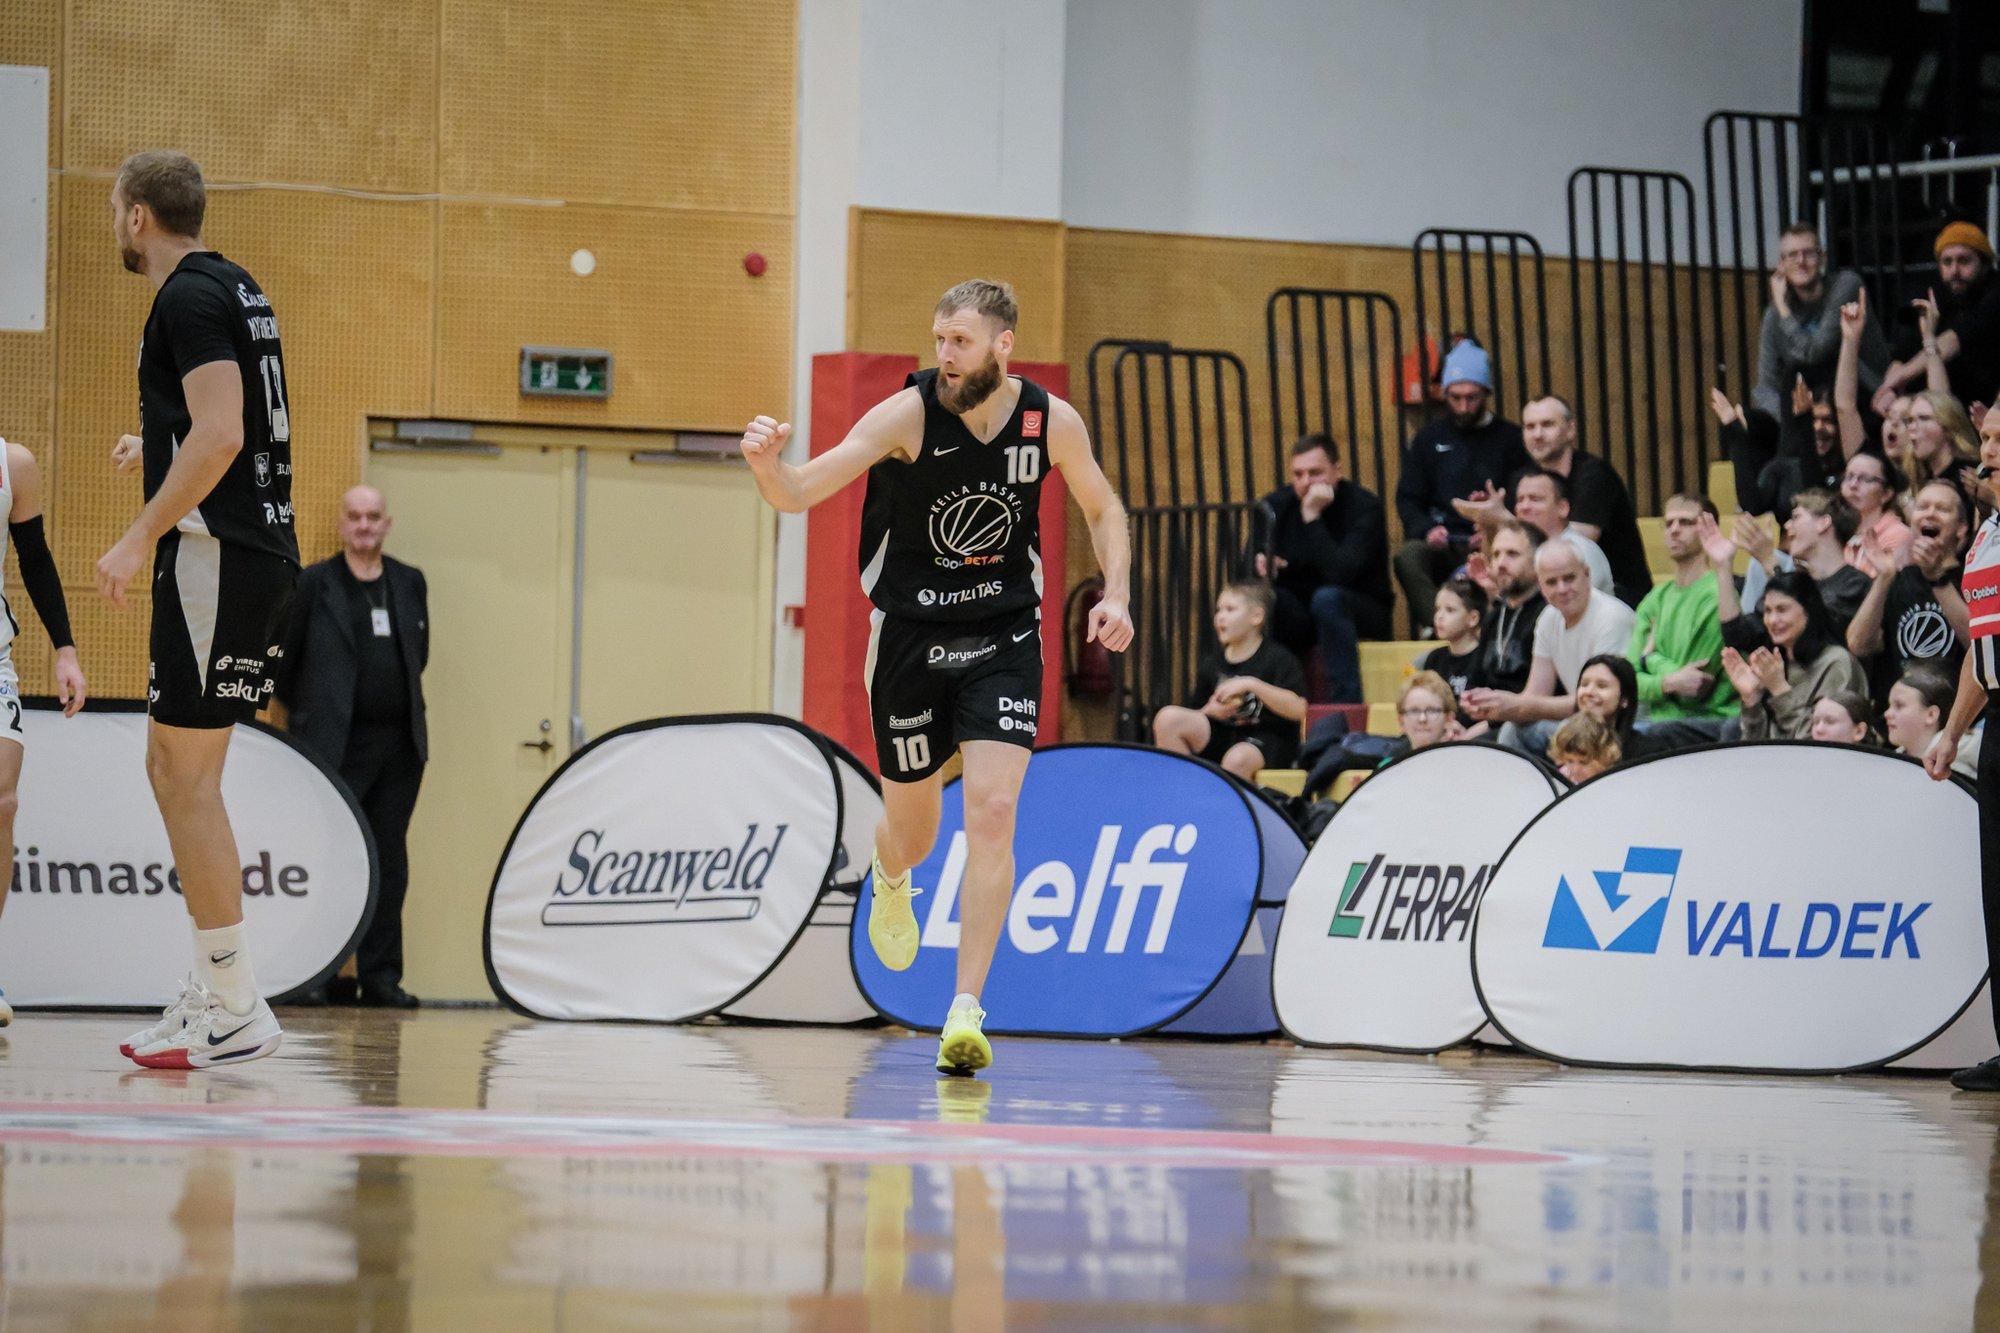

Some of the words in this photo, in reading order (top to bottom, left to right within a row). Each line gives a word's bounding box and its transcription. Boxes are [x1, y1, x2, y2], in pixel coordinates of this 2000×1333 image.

[1004, 445, 1041, 485] 10
[931, 485, 970, 513] KEILA
[939, 580, 1003, 605] UTILITAS
[1971, 585, 1998, 601] Optibet
[948, 644, 997, 662] prysmian
[234, 665, 260, 675] EHITUS
[216, 678, 260, 701] saku
[889, 709, 933, 727] Scanweld
[998, 697, 1036, 717] Delfi
[1015, 719, 1037, 737] Daily
[892, 733, 931, 772] 10
[10, 846, 309, 897] iimasede
[554, 823, 789, 909] Scanweld
[1366, 864, 1500, 942] TERRA
[1686, 902, 1932, 959] VALDEK
